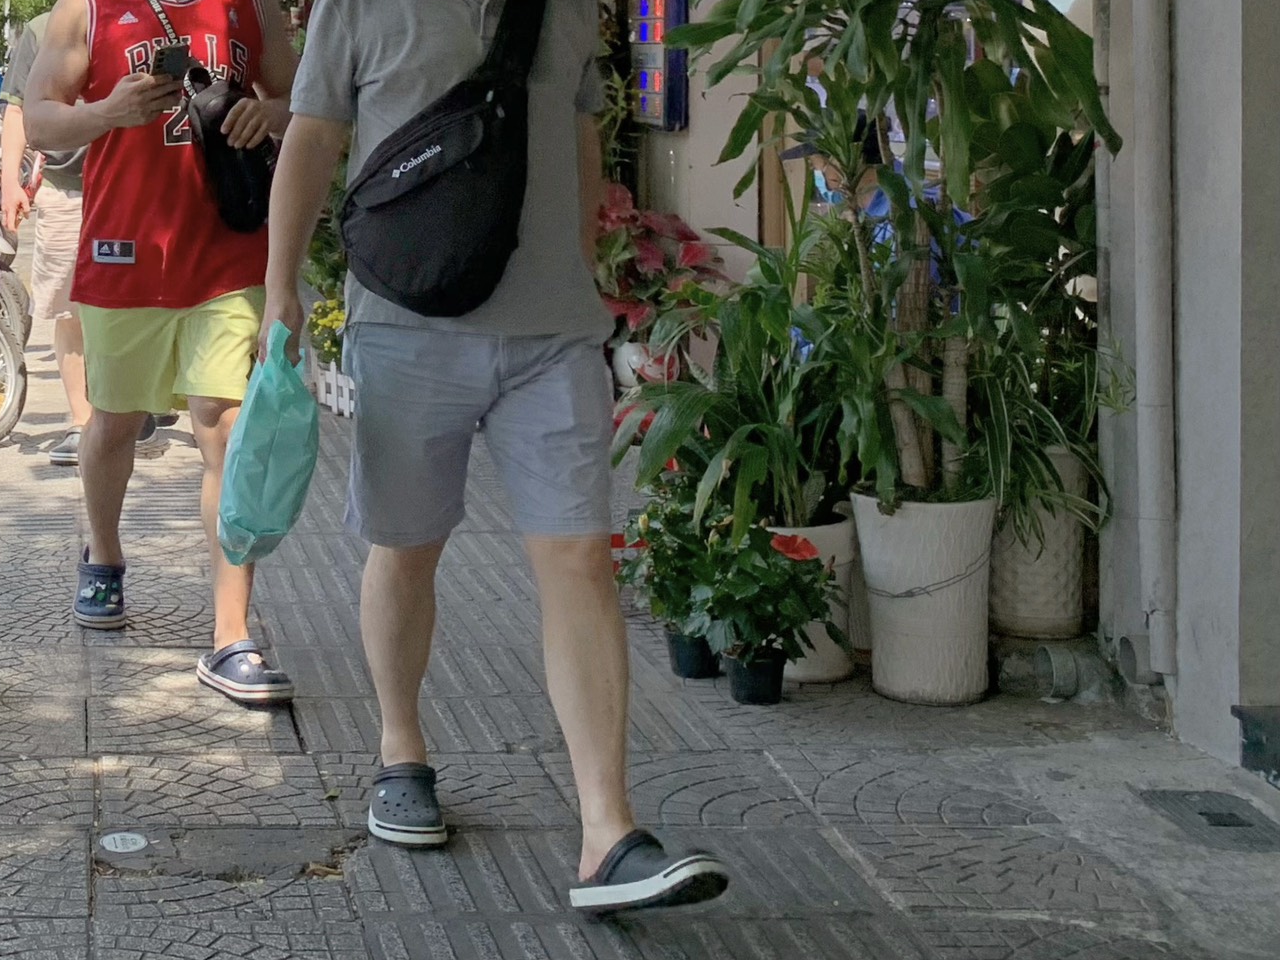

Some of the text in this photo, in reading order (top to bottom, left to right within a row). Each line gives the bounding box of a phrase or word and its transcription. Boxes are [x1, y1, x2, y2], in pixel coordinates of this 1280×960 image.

[158, 12, 178, 45] BASEBA
[163, 106, 193, 146] 2
[399, 144, 442, 173] Columbia
